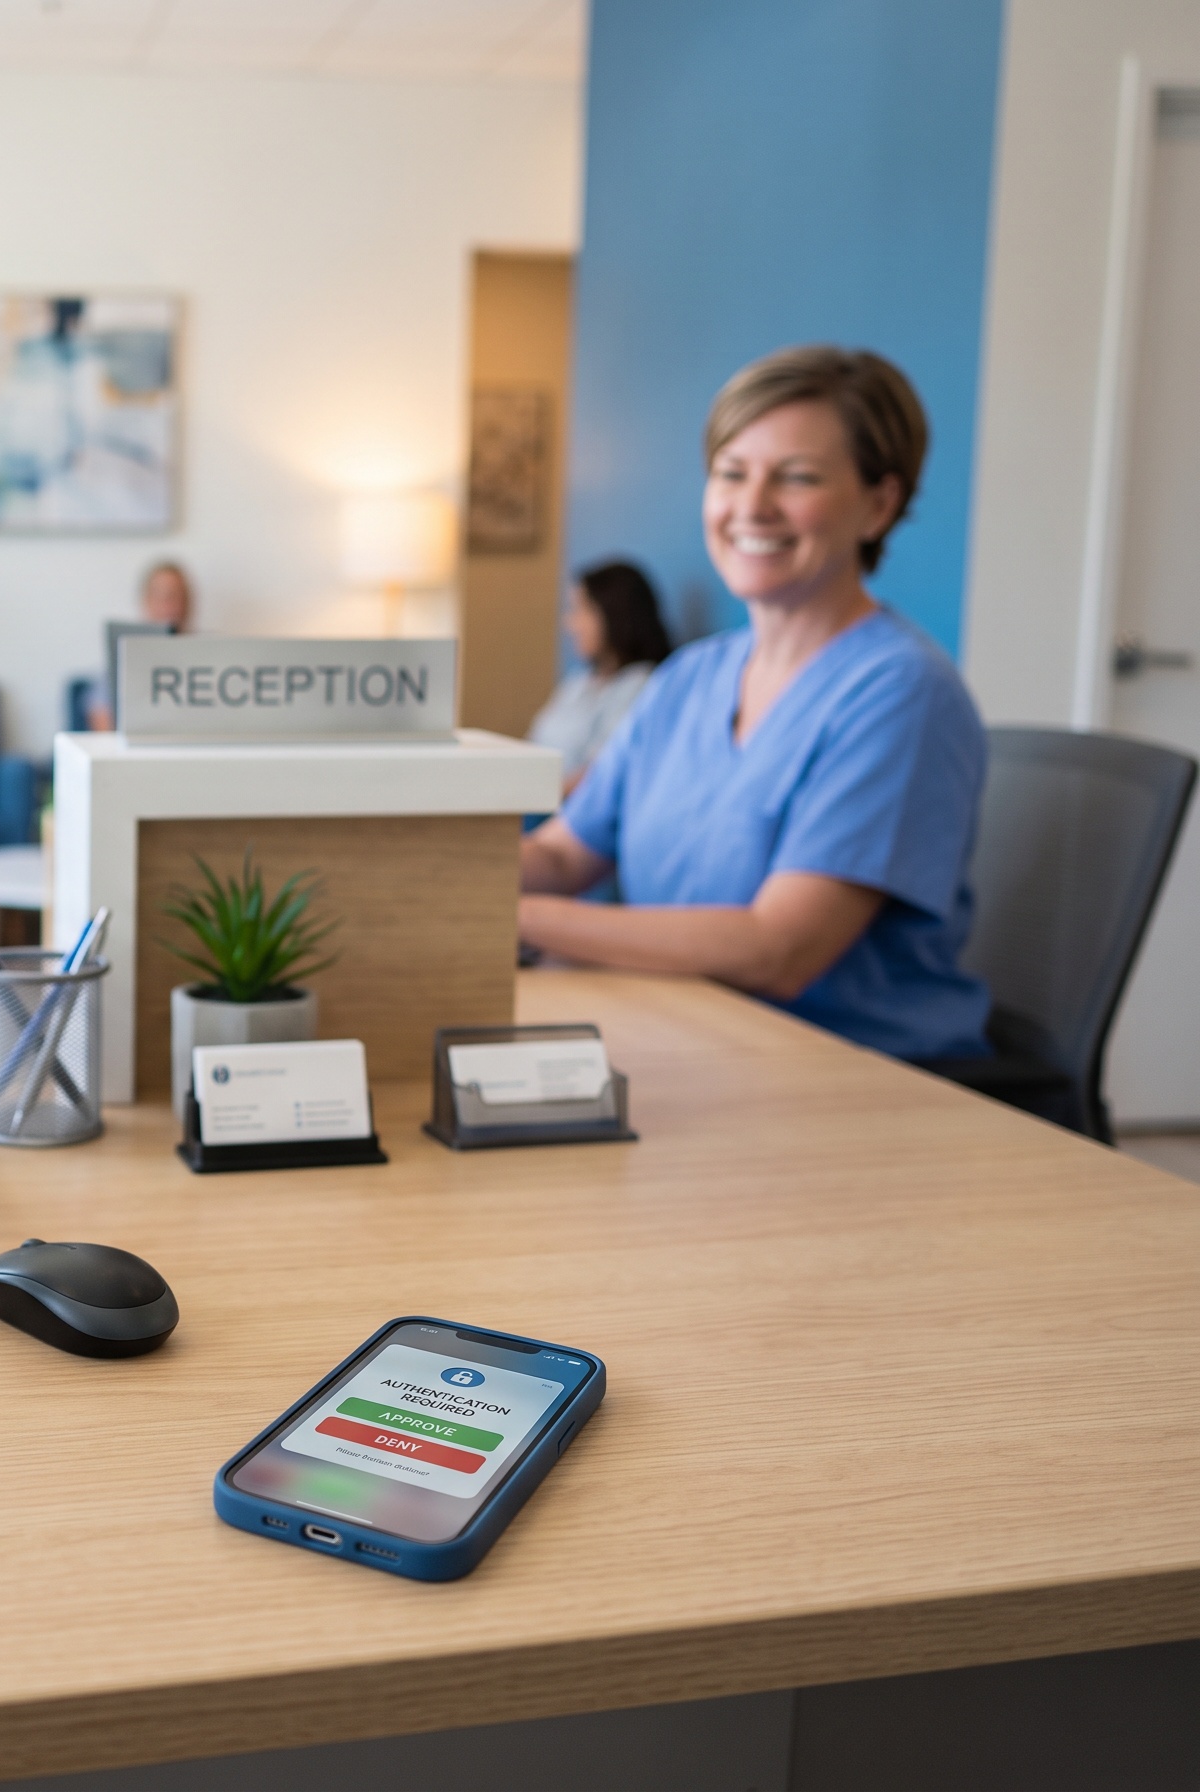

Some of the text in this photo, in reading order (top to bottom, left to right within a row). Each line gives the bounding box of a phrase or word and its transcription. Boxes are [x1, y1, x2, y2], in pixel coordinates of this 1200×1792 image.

[150, 664, 430, 708] RECEPTION
[380, 1378, 512, 1416] AUTHENTICATION
[400, 1393, 475, 1418] REQUIRED
[378, 1411, 457, 1437] APPROVE
[374, 1435, 423, 1453] DENY
